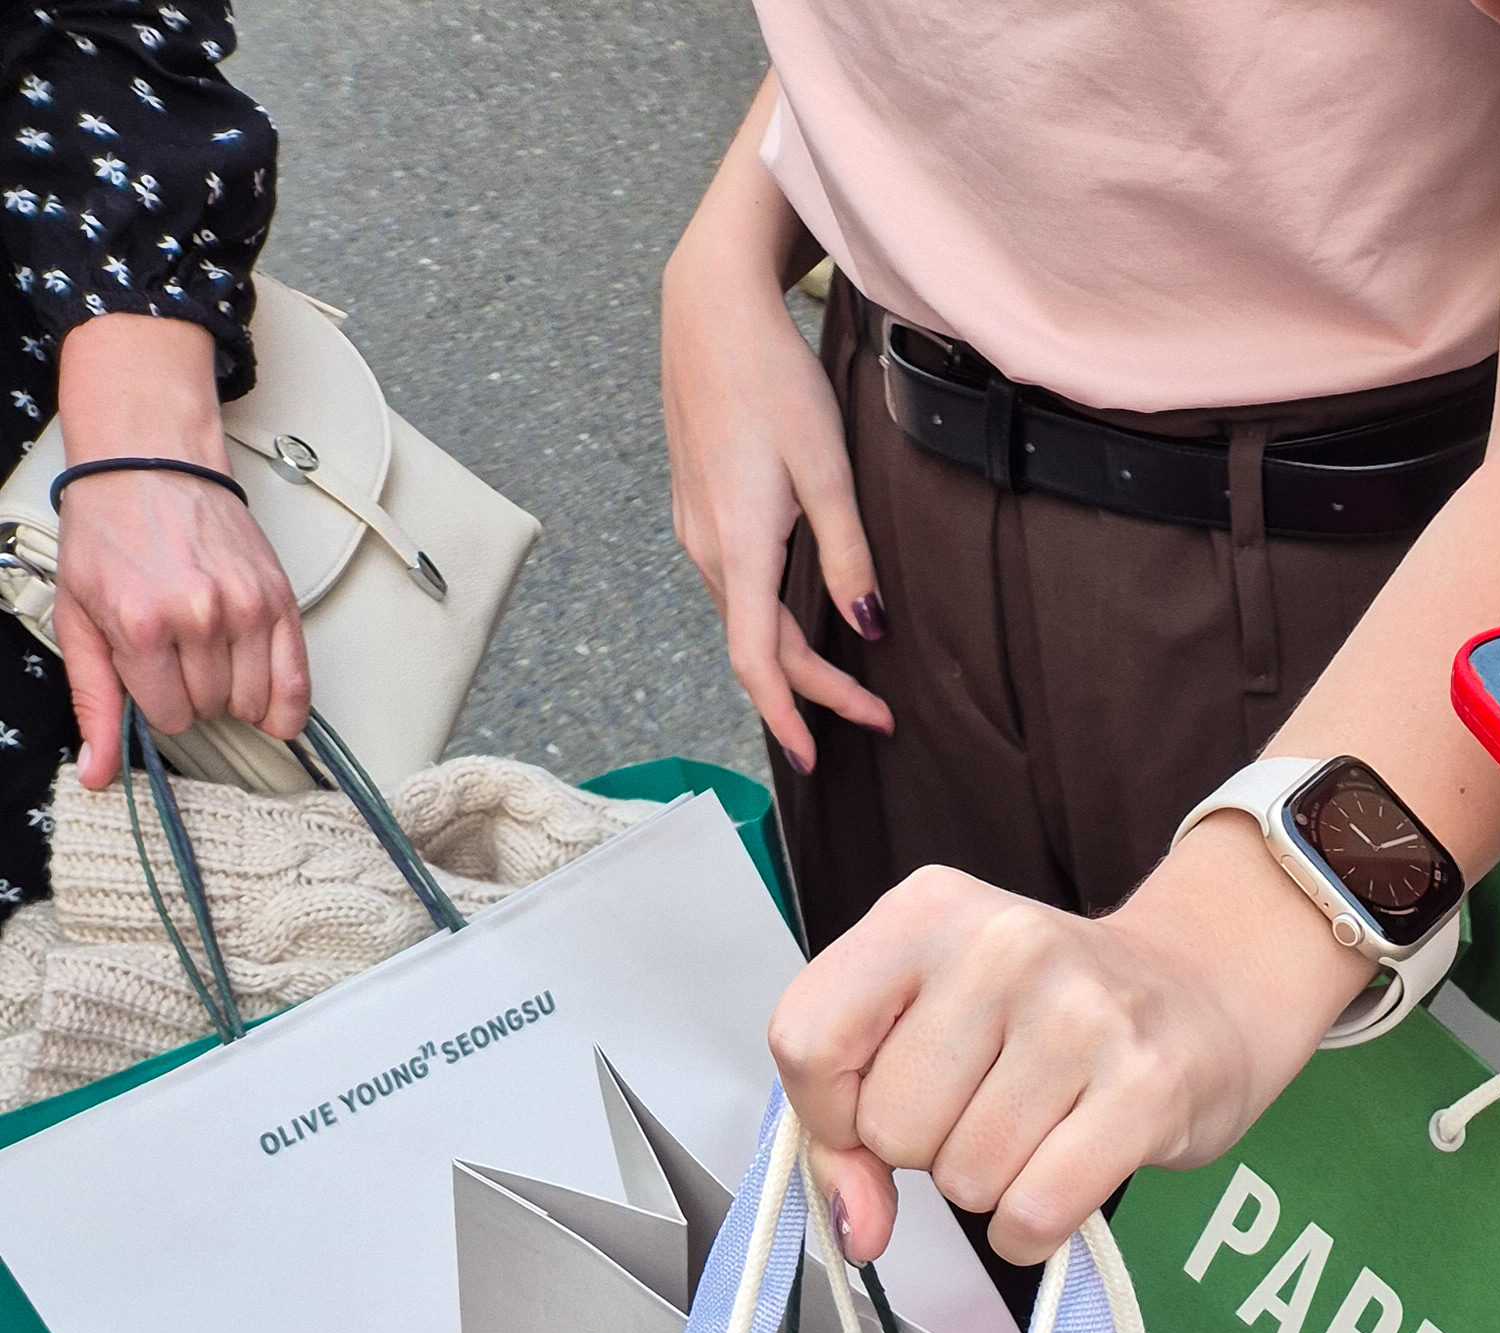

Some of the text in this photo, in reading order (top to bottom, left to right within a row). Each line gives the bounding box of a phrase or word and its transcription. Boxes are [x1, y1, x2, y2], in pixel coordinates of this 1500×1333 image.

[258, 1102, 338, 1156] OLIVE
[338, 1055, 430, 1113] YOUNG
[439, 990, 557, 1064] SEONGSU
